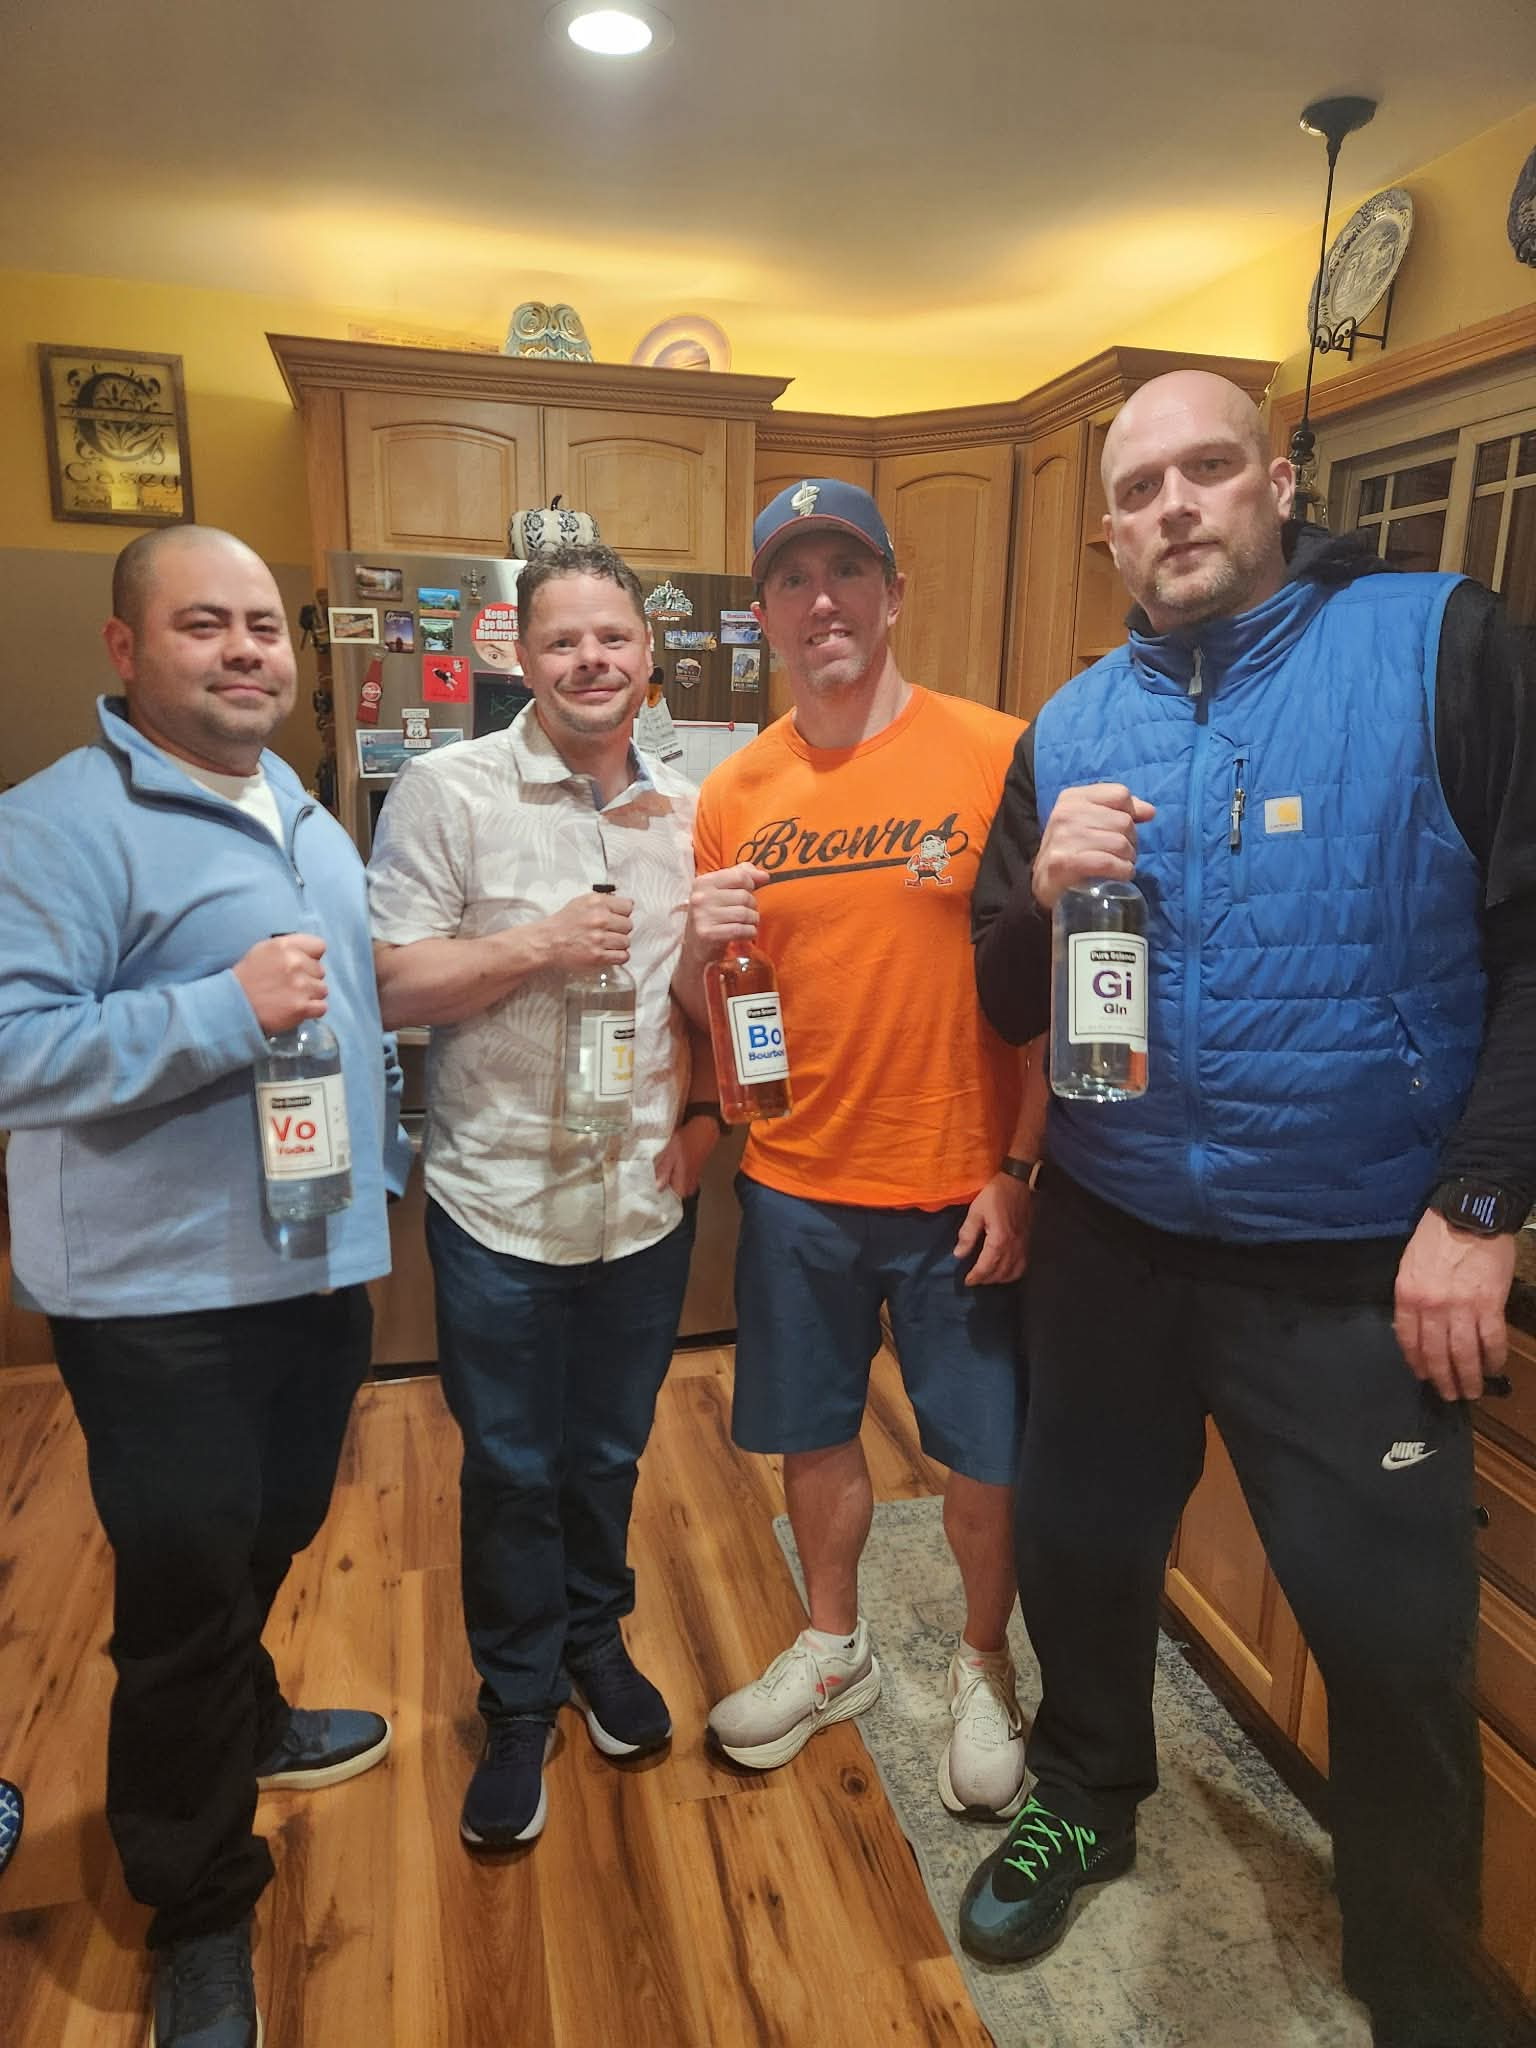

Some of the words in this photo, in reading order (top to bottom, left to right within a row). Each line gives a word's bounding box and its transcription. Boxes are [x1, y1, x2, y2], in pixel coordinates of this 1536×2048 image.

[484, 608, 509, 621] Keep
[479, 618, 496, 631] Eye
[475, 628, 519, 641] Motorcyc
[736, 813, 969, 870] Browns
[1092, 970, 1132, 1001] Gi
[1103, 1003, 1127, 1015] Gin
[748, 1024, 782, 1048] Bo
[749, 1049, 785, 1061] Bourbo
[271, 1116, 316, 1142] Vo
[1391, 1441, 1426, 1459] NIKE
